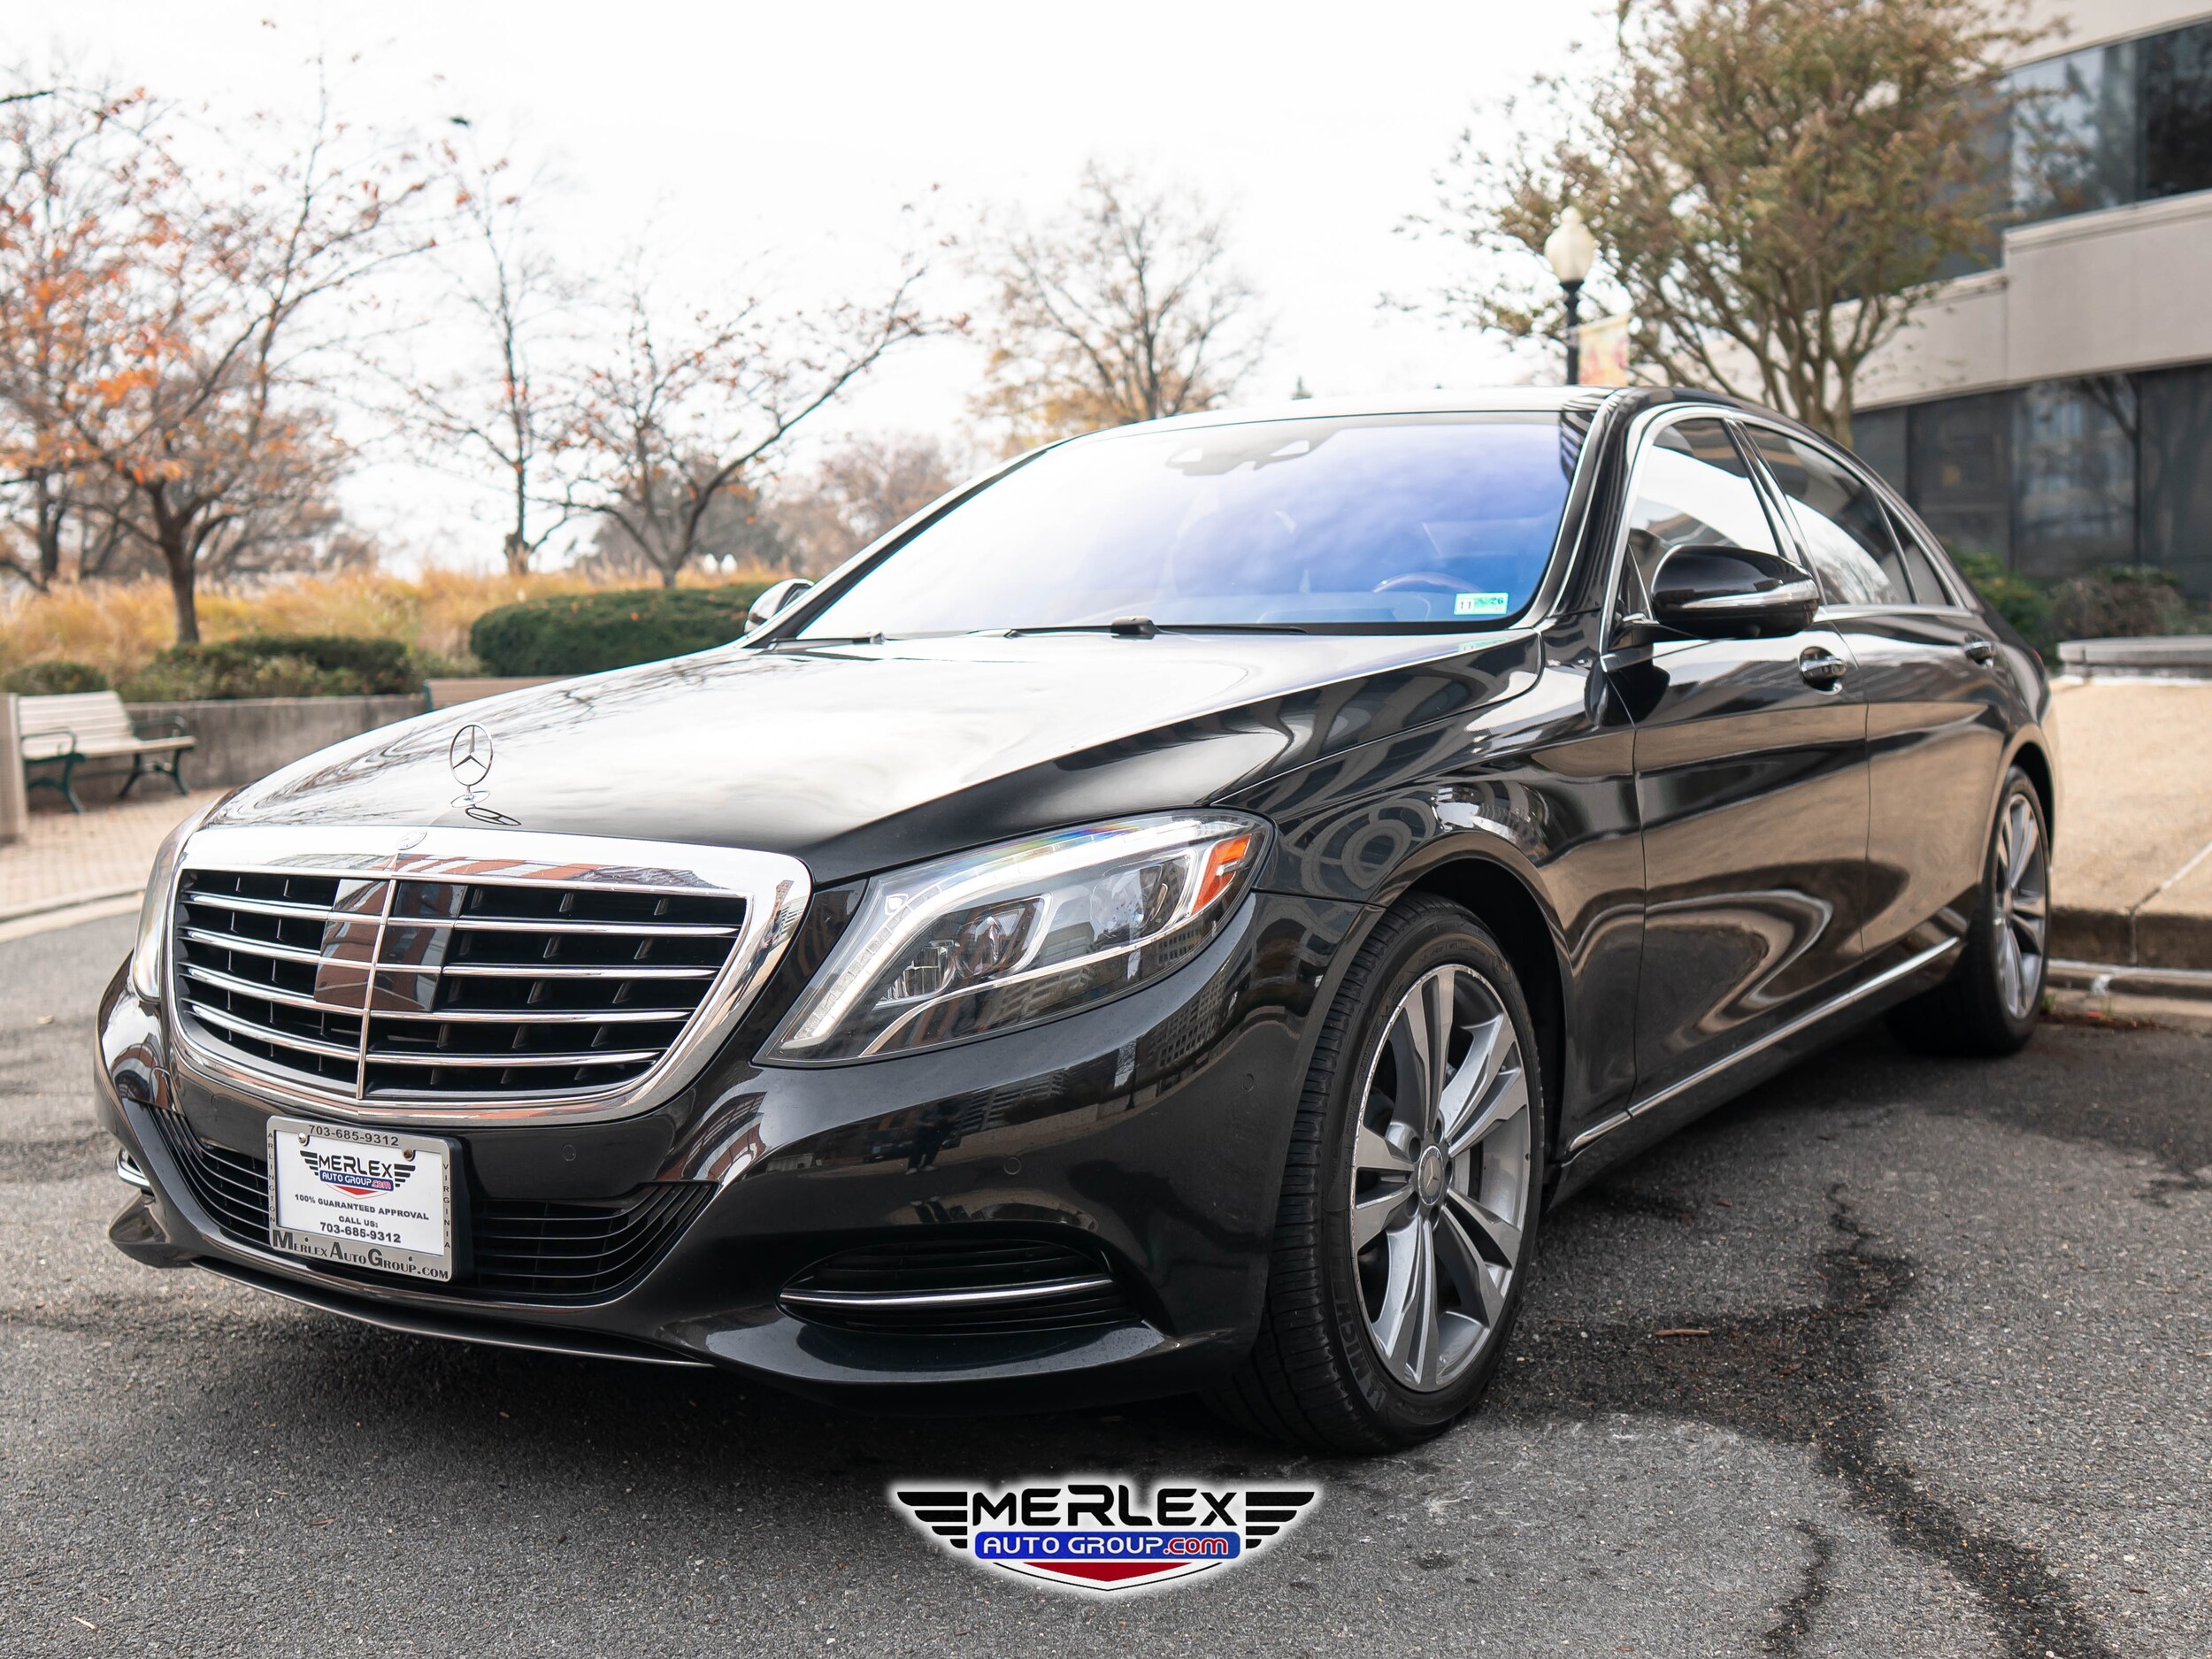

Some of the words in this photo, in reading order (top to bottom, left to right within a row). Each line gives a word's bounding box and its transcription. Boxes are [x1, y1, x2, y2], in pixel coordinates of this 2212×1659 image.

[308, 1124, 399, 1147] 703-685-9312
[319, 1154, 393, 1179] MERLEX
[321, 1171, 343, 1183] AUTO
[295, 1194, 316, 1204] 100%
[318, 1197, 376, 1214] GUARANTEED
[378, 1207, 429, 1220] APPROVAL
[442, 1163, 451, 1248] VIRGINIA
[319, 1221, 402, 1244] 703-685-9312
[338, 1215, 362, 1225] CALL
[364, 1219, 379, 1228] US:
